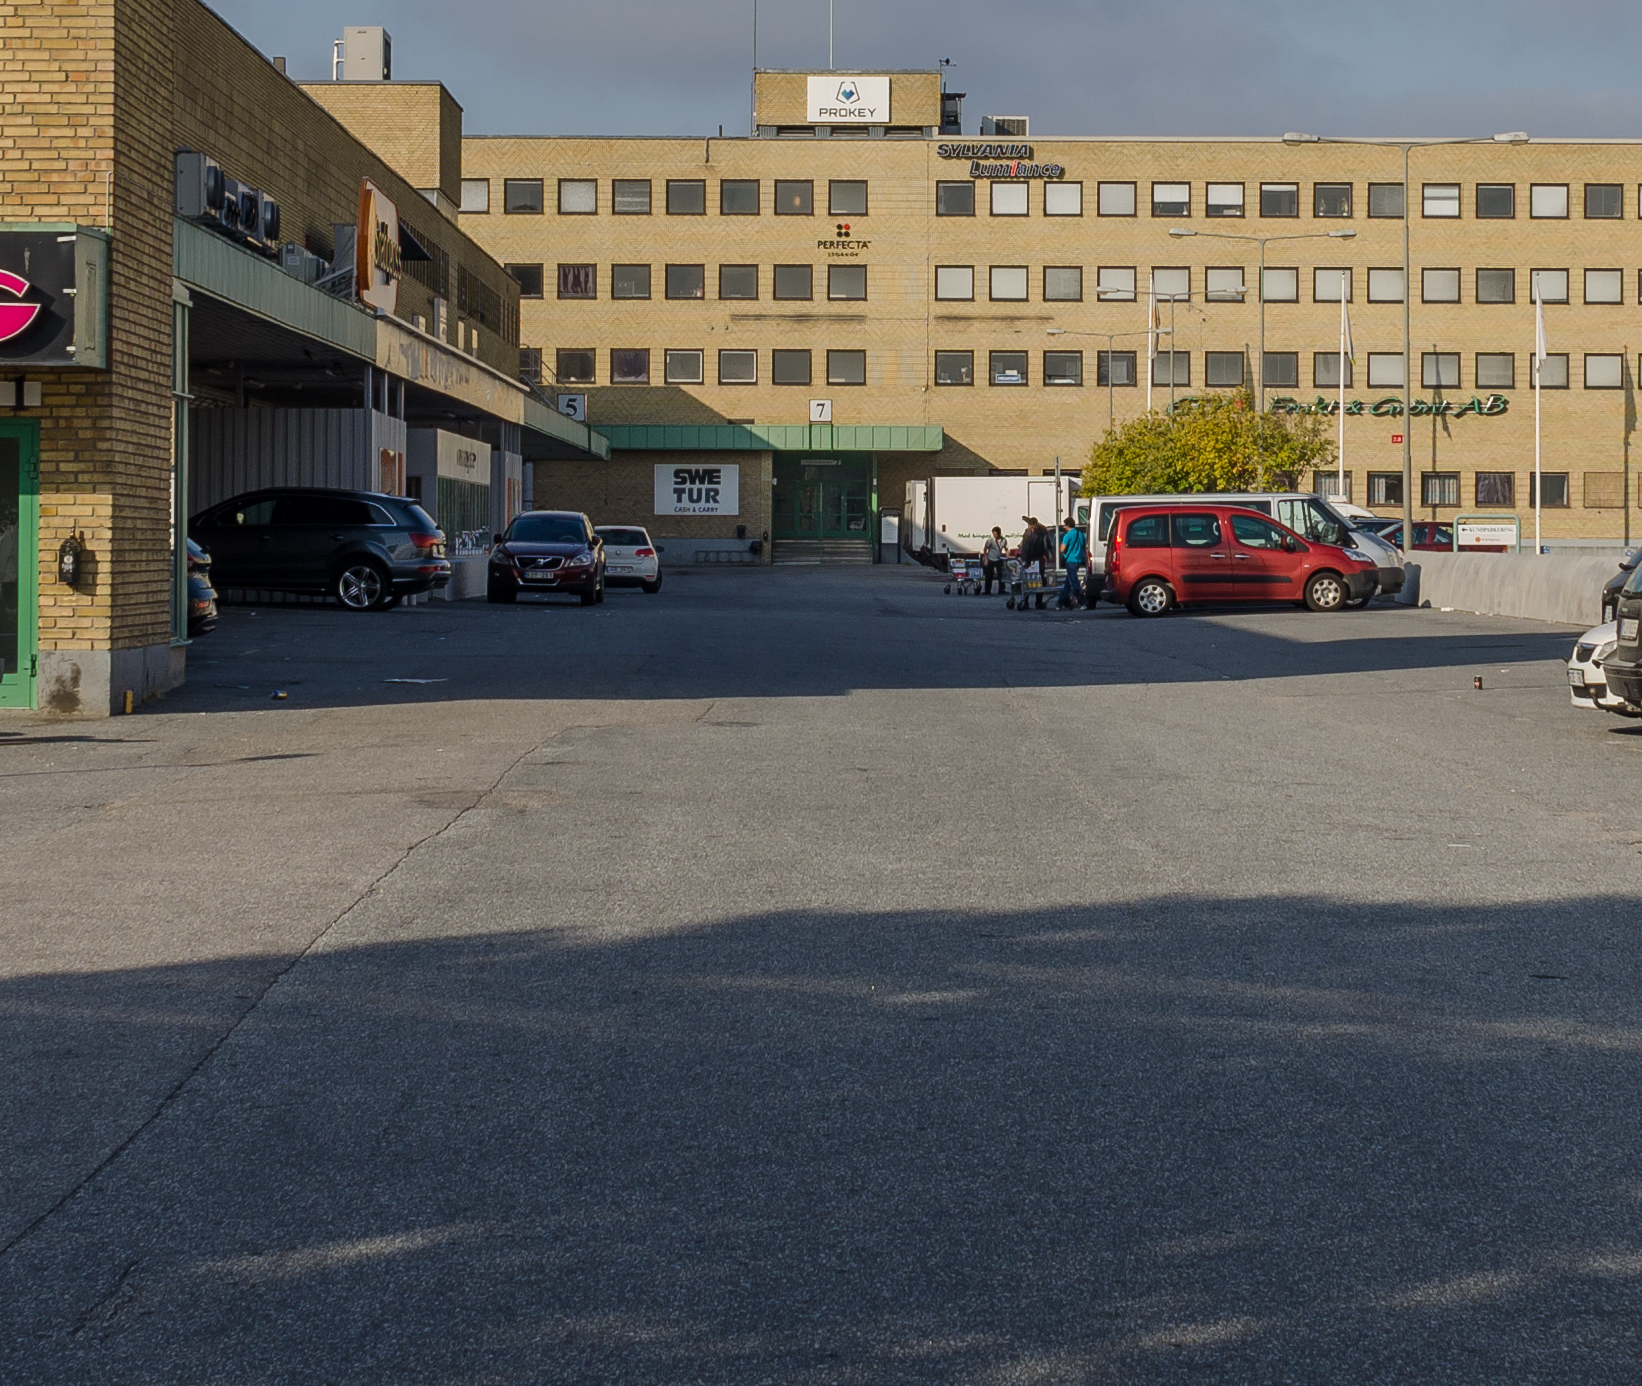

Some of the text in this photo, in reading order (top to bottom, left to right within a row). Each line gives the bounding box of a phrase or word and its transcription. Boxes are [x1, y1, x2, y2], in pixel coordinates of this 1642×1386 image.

[819, 108, 876, 117] PROKEY
[936, 143, 1031, 158] SYLVANIA
[969, 160, 1063, 177] Lumiance
[565, 398, 578, 416] 5
[816, 403, 825, 418] 7
[1344, 400, 1365, 415] &
[1450, 394, 1508, 417] AB
[673, 468, 721, 485] SWE
[673, 488, 720, 504] TUR
